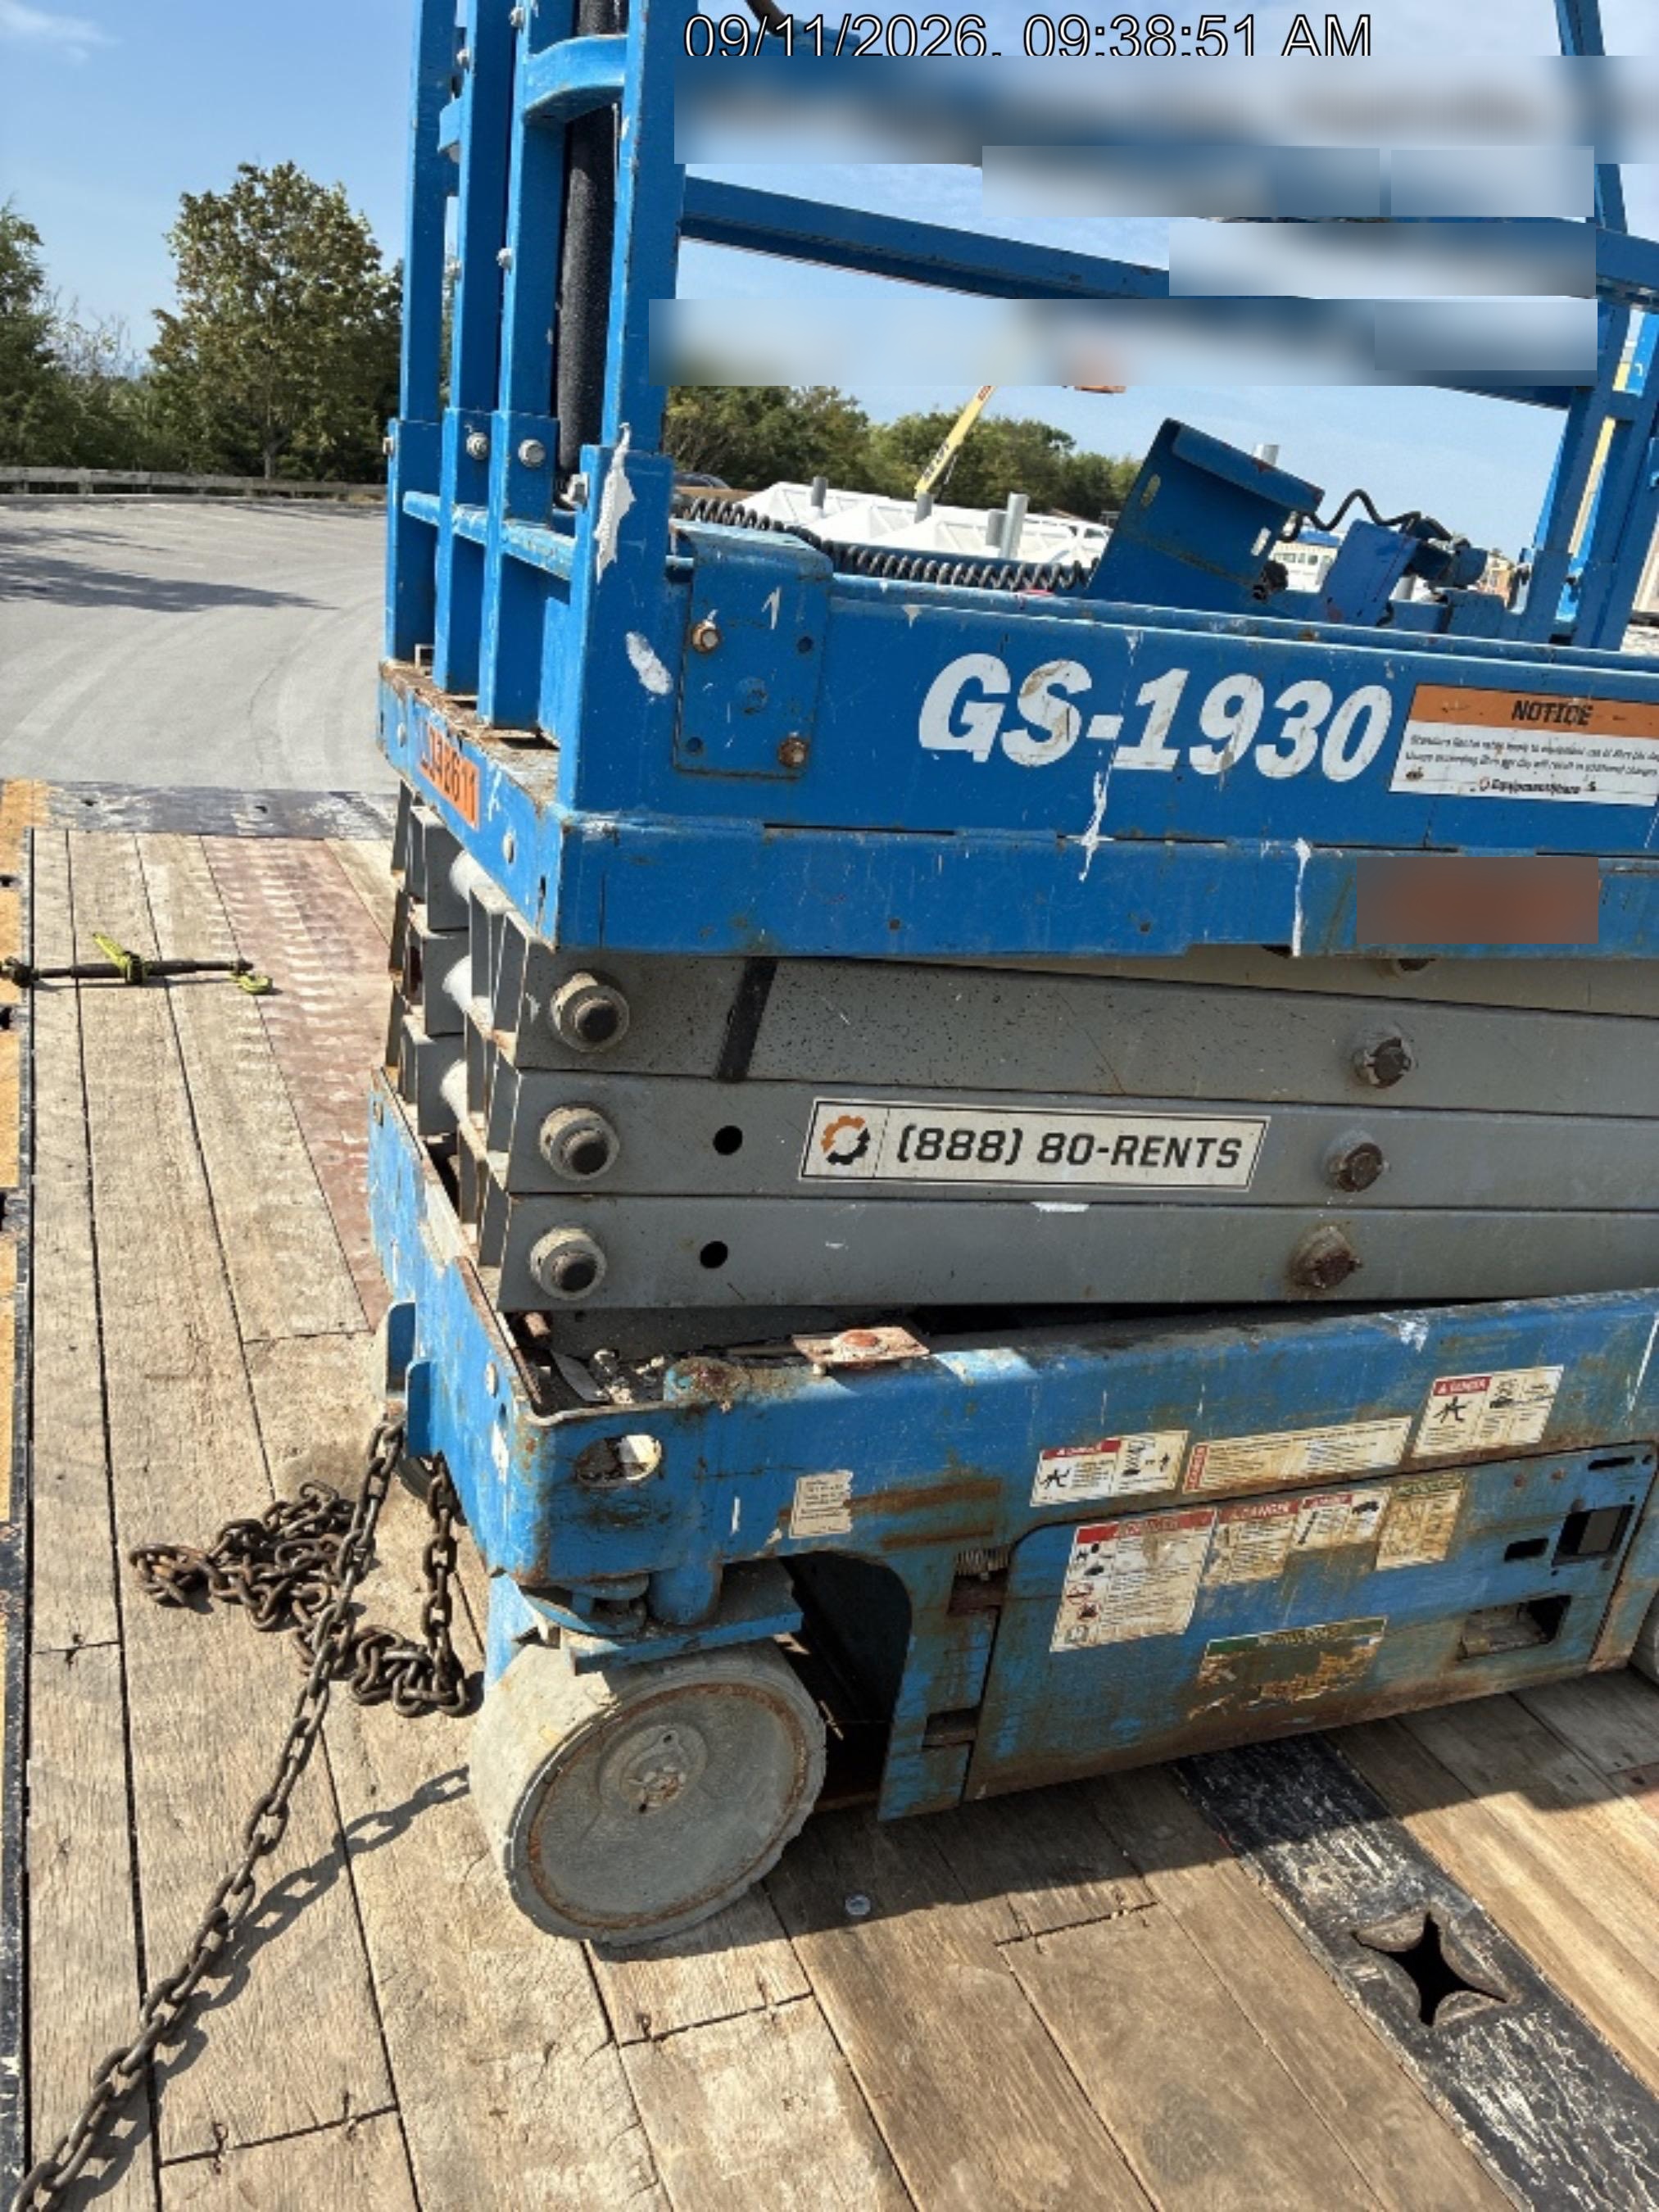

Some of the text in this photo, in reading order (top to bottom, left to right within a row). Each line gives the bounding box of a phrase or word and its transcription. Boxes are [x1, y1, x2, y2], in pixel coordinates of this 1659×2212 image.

[918, 654, 1392, 782] GS-1930
[1512, 700, 1593, 726] NOTICE
[897, 1124, 1244, 1168] (888) 80-RENTS
